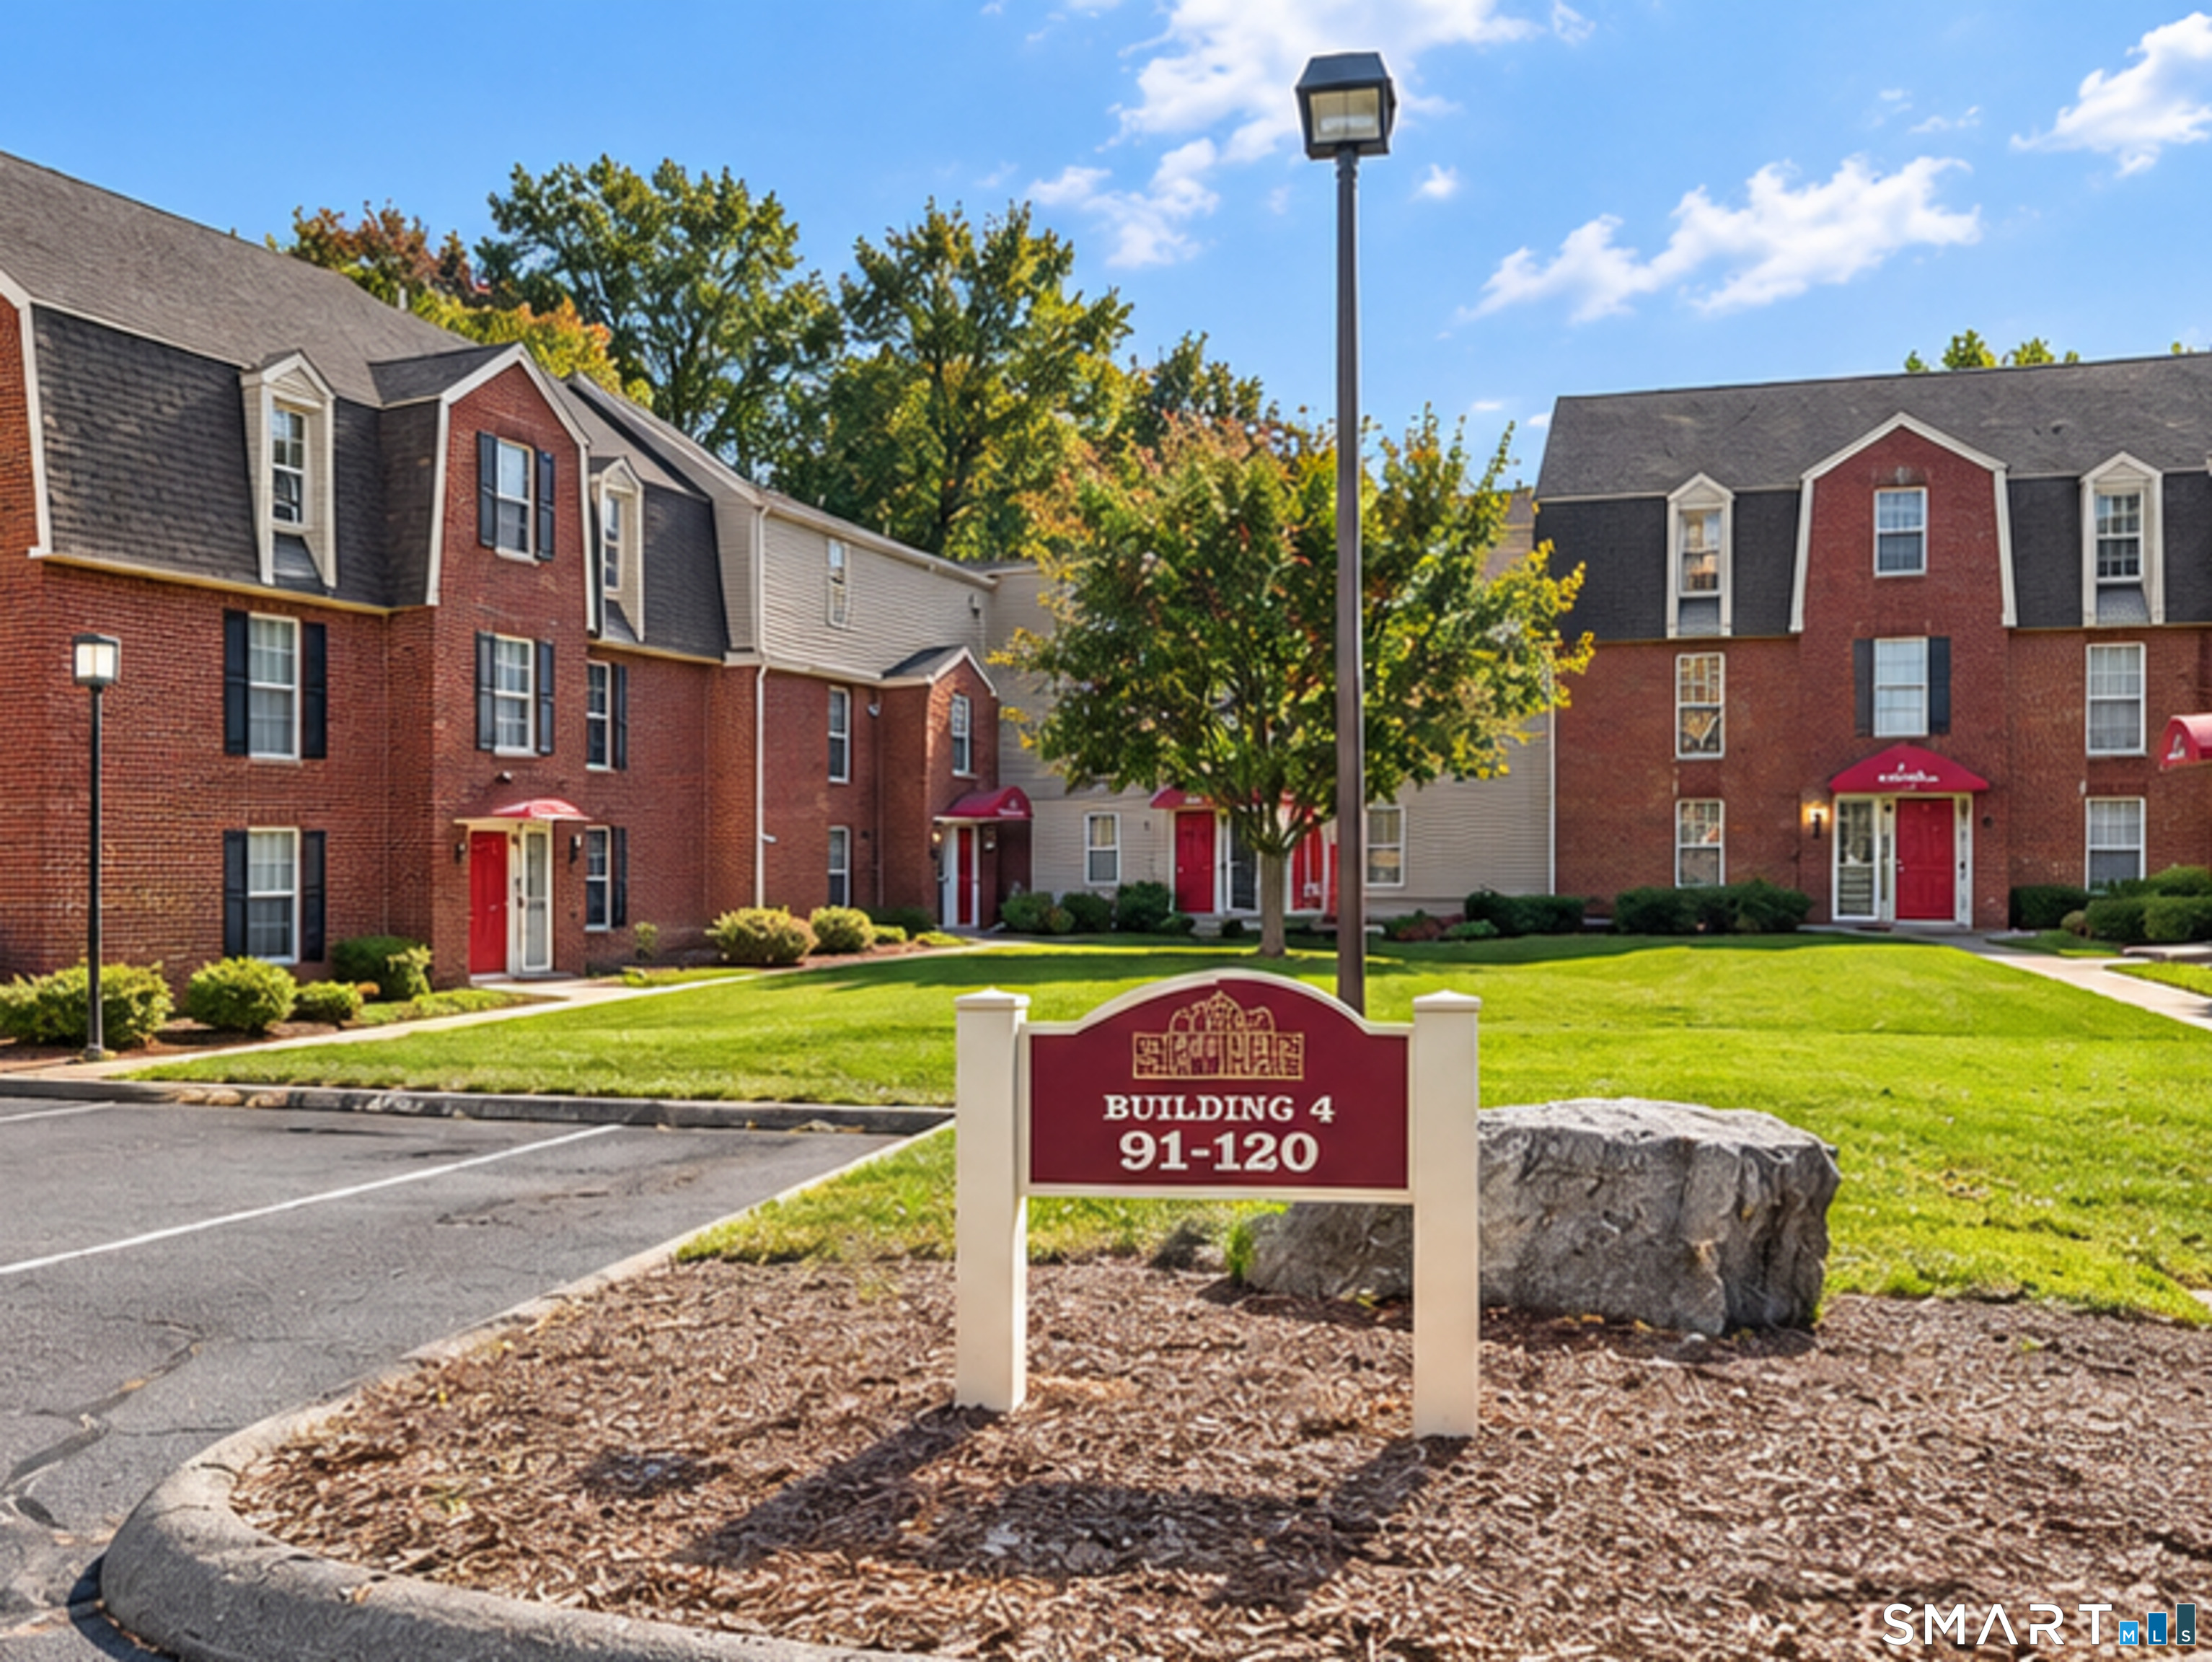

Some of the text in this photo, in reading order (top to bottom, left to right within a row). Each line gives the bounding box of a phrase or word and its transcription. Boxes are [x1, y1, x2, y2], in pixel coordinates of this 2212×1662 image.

[1104, 1095, 1334, 1122] BUILDING 4
[1120, 1130, 1318, 1171] 91-120
